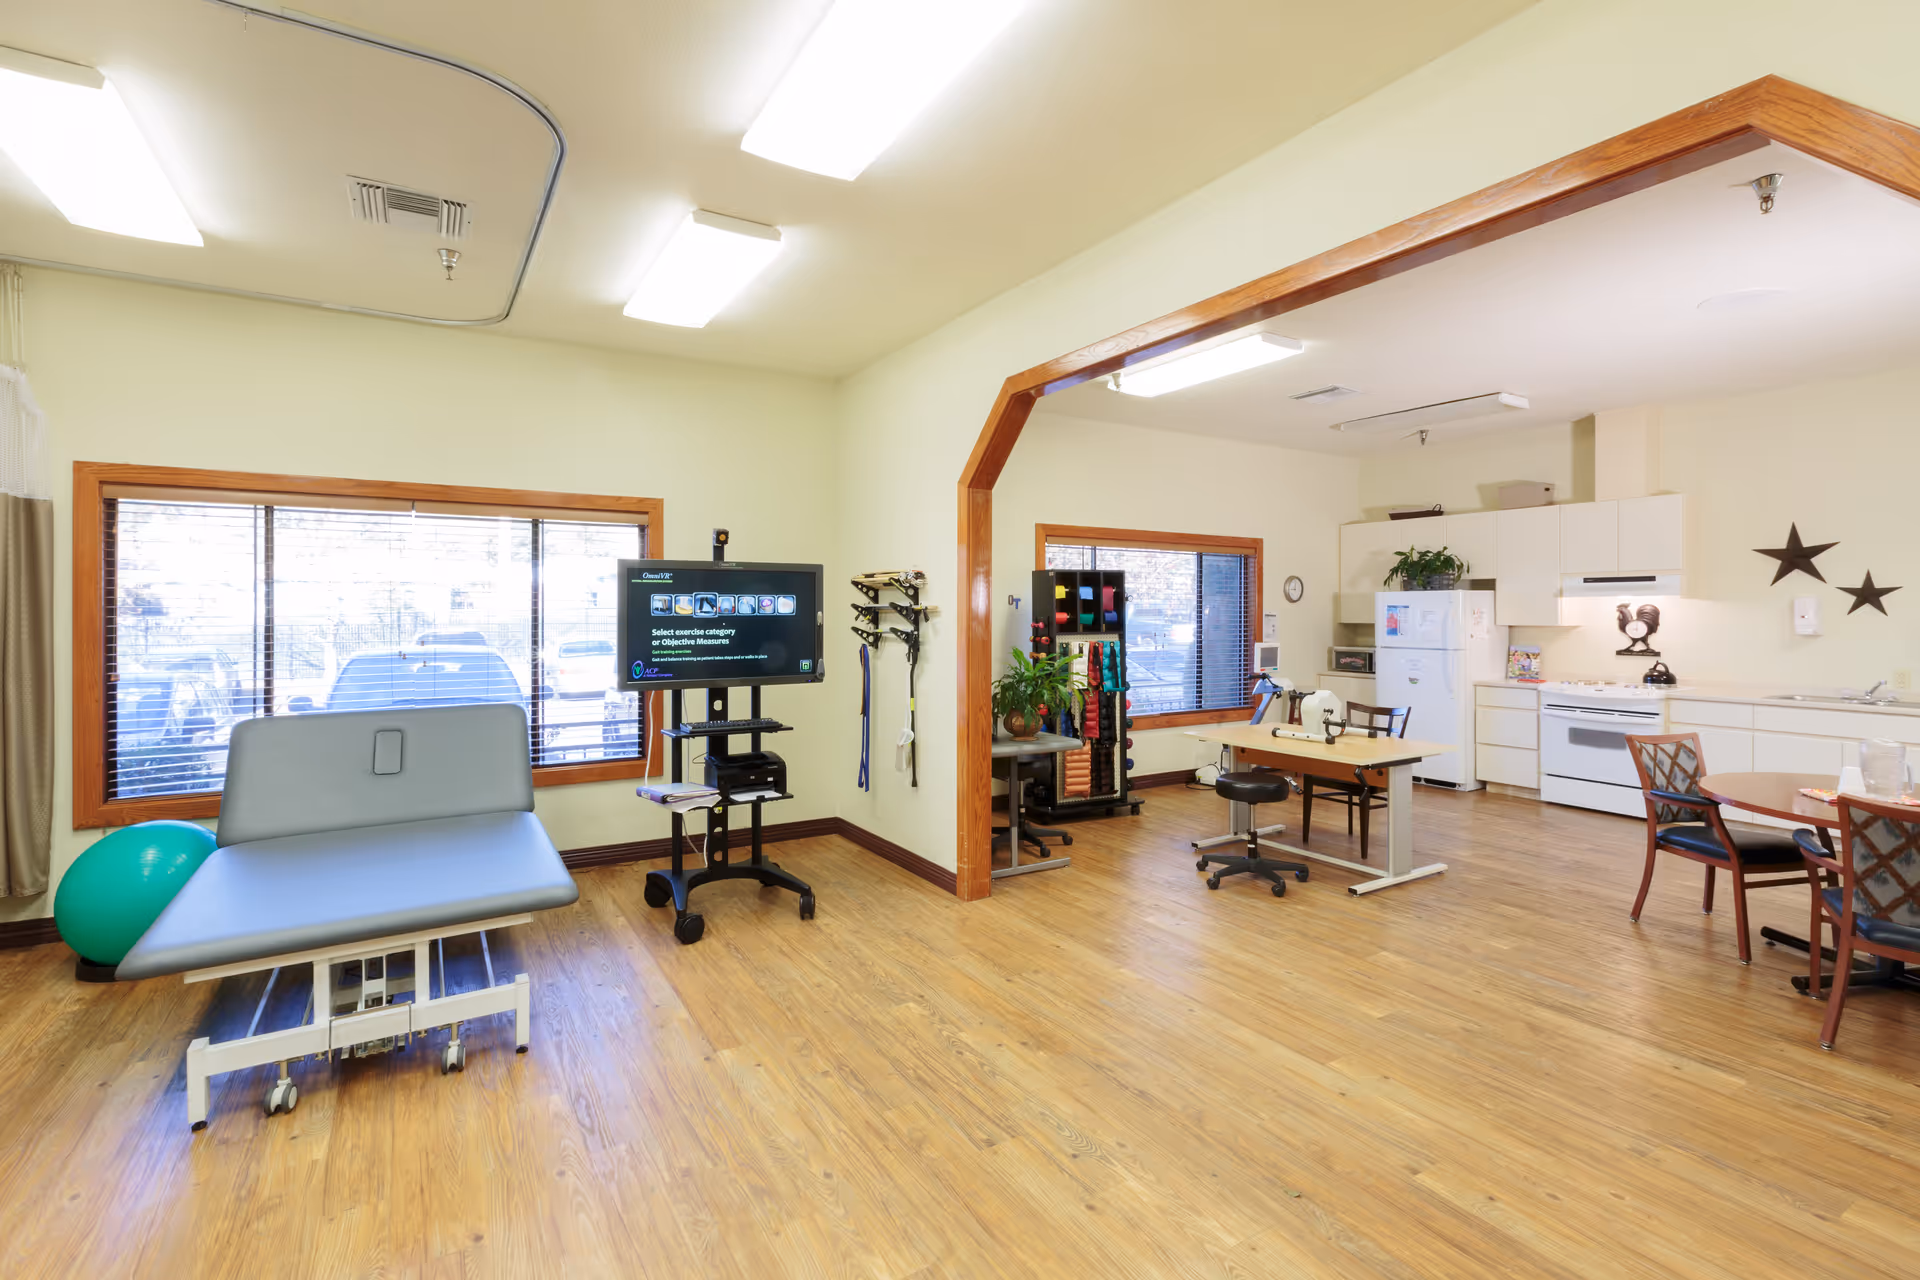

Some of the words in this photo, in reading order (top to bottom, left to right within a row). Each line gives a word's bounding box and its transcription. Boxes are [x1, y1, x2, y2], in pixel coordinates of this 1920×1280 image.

[651, 628, 674, 636] Select
[675, 628, 704, 636] exercise
[705, 628, 736, 637] category
[661, 638, 695, 647] Objective
